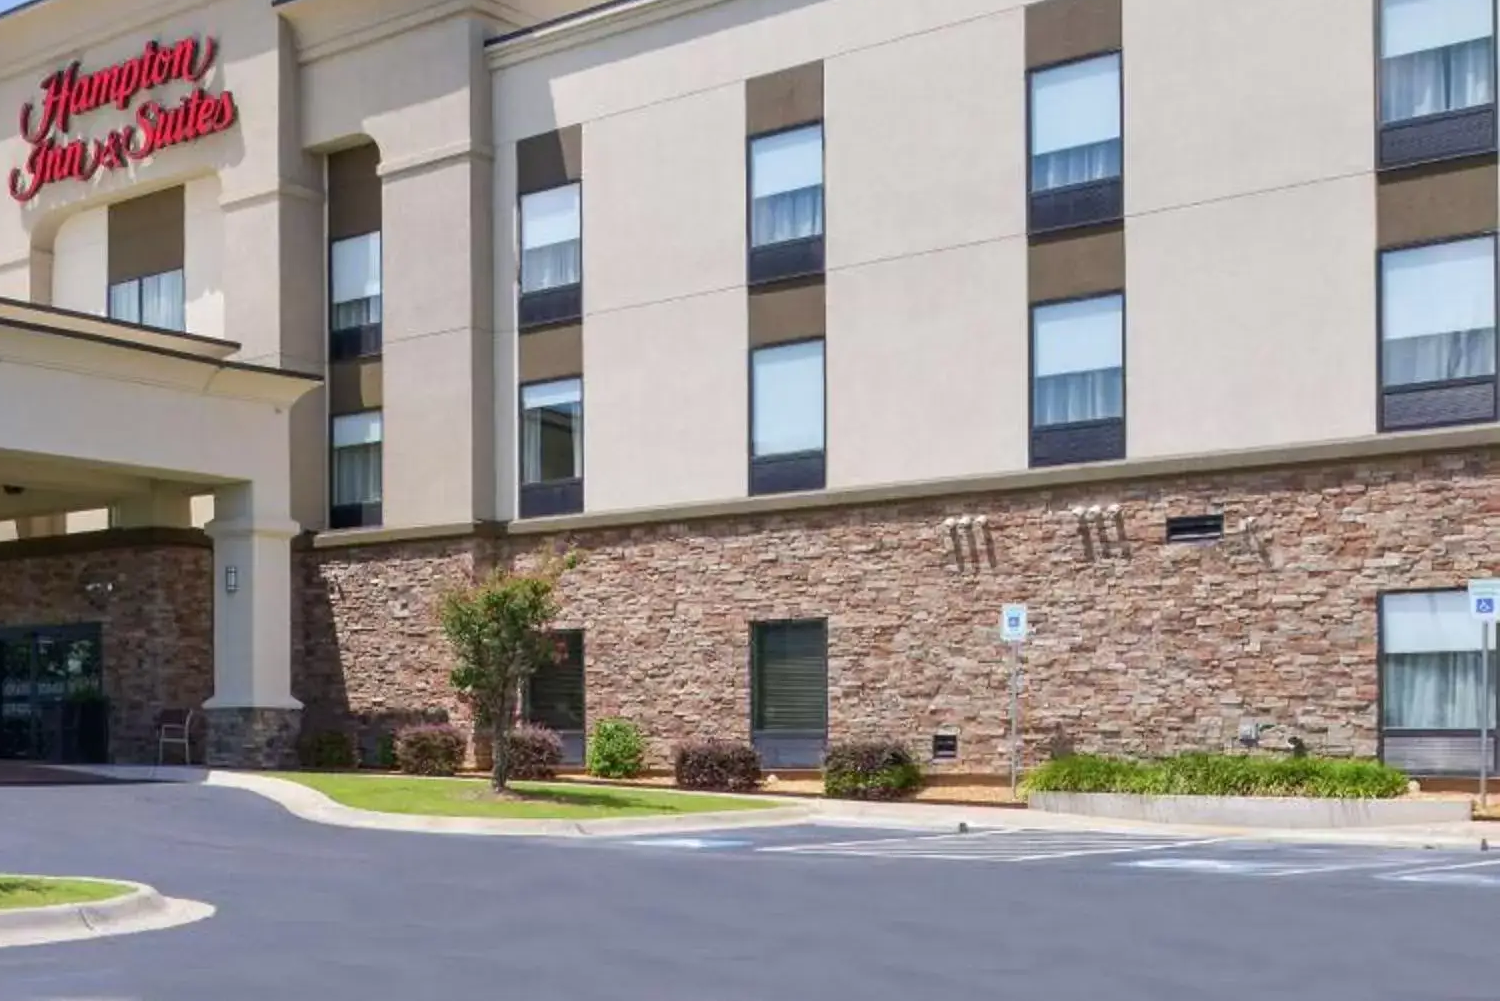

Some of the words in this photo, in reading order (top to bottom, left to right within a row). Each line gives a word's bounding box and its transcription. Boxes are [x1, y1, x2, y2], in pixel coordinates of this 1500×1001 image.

[9, 137, 101, 202] Inn
[122, 87, 237, 160] Suites
[20, 35, 218, 145] Hampton
